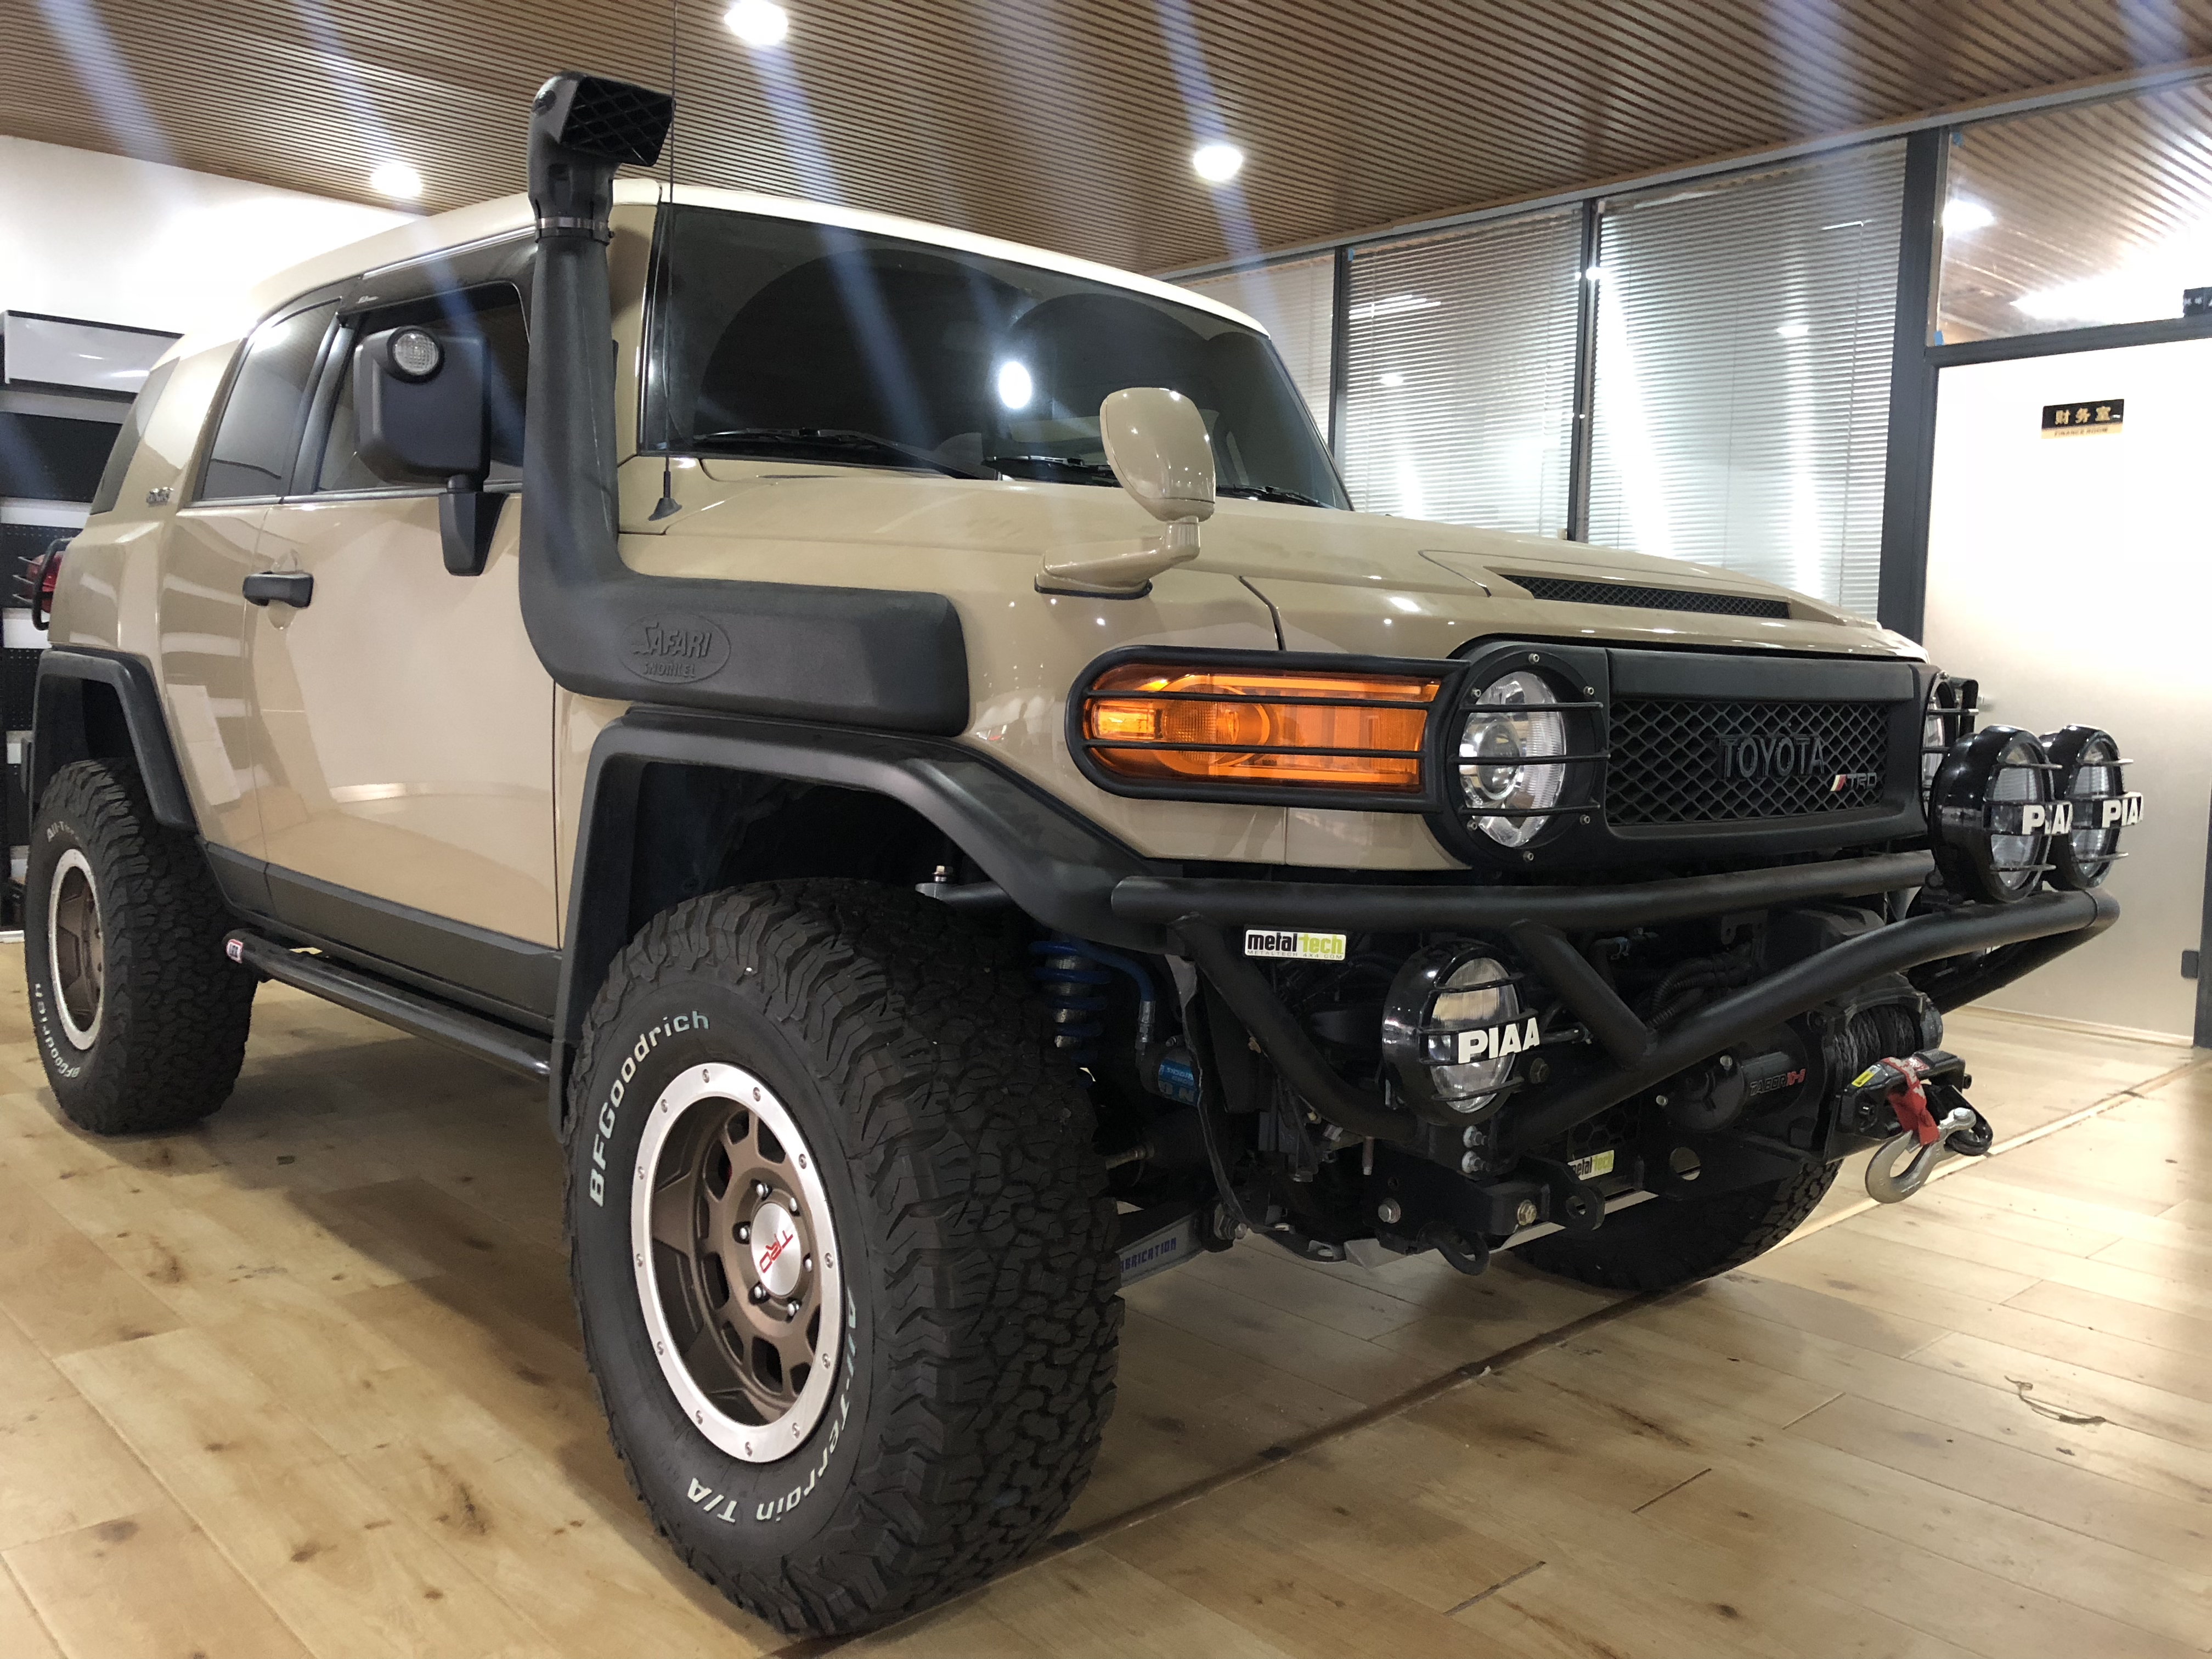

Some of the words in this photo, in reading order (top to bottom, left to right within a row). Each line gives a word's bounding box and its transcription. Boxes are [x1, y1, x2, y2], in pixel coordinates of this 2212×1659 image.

[2055, 405, 2112, 425] 财务室
[632, 622, 713, 658] SAFARI
[1719, 736, 1825, 778] TOYOTA
[1847, 772, 1877, 791] TRD
[1458, 1017, 1540, 1064] PIAA
[1750, 1074, 1787, 1096] TABOR
[590, 1011, 709, 1207] BFGoodrich
[759, 1230, 793, 1273] TRD
[687, 1477, 737, 1522] T/A
